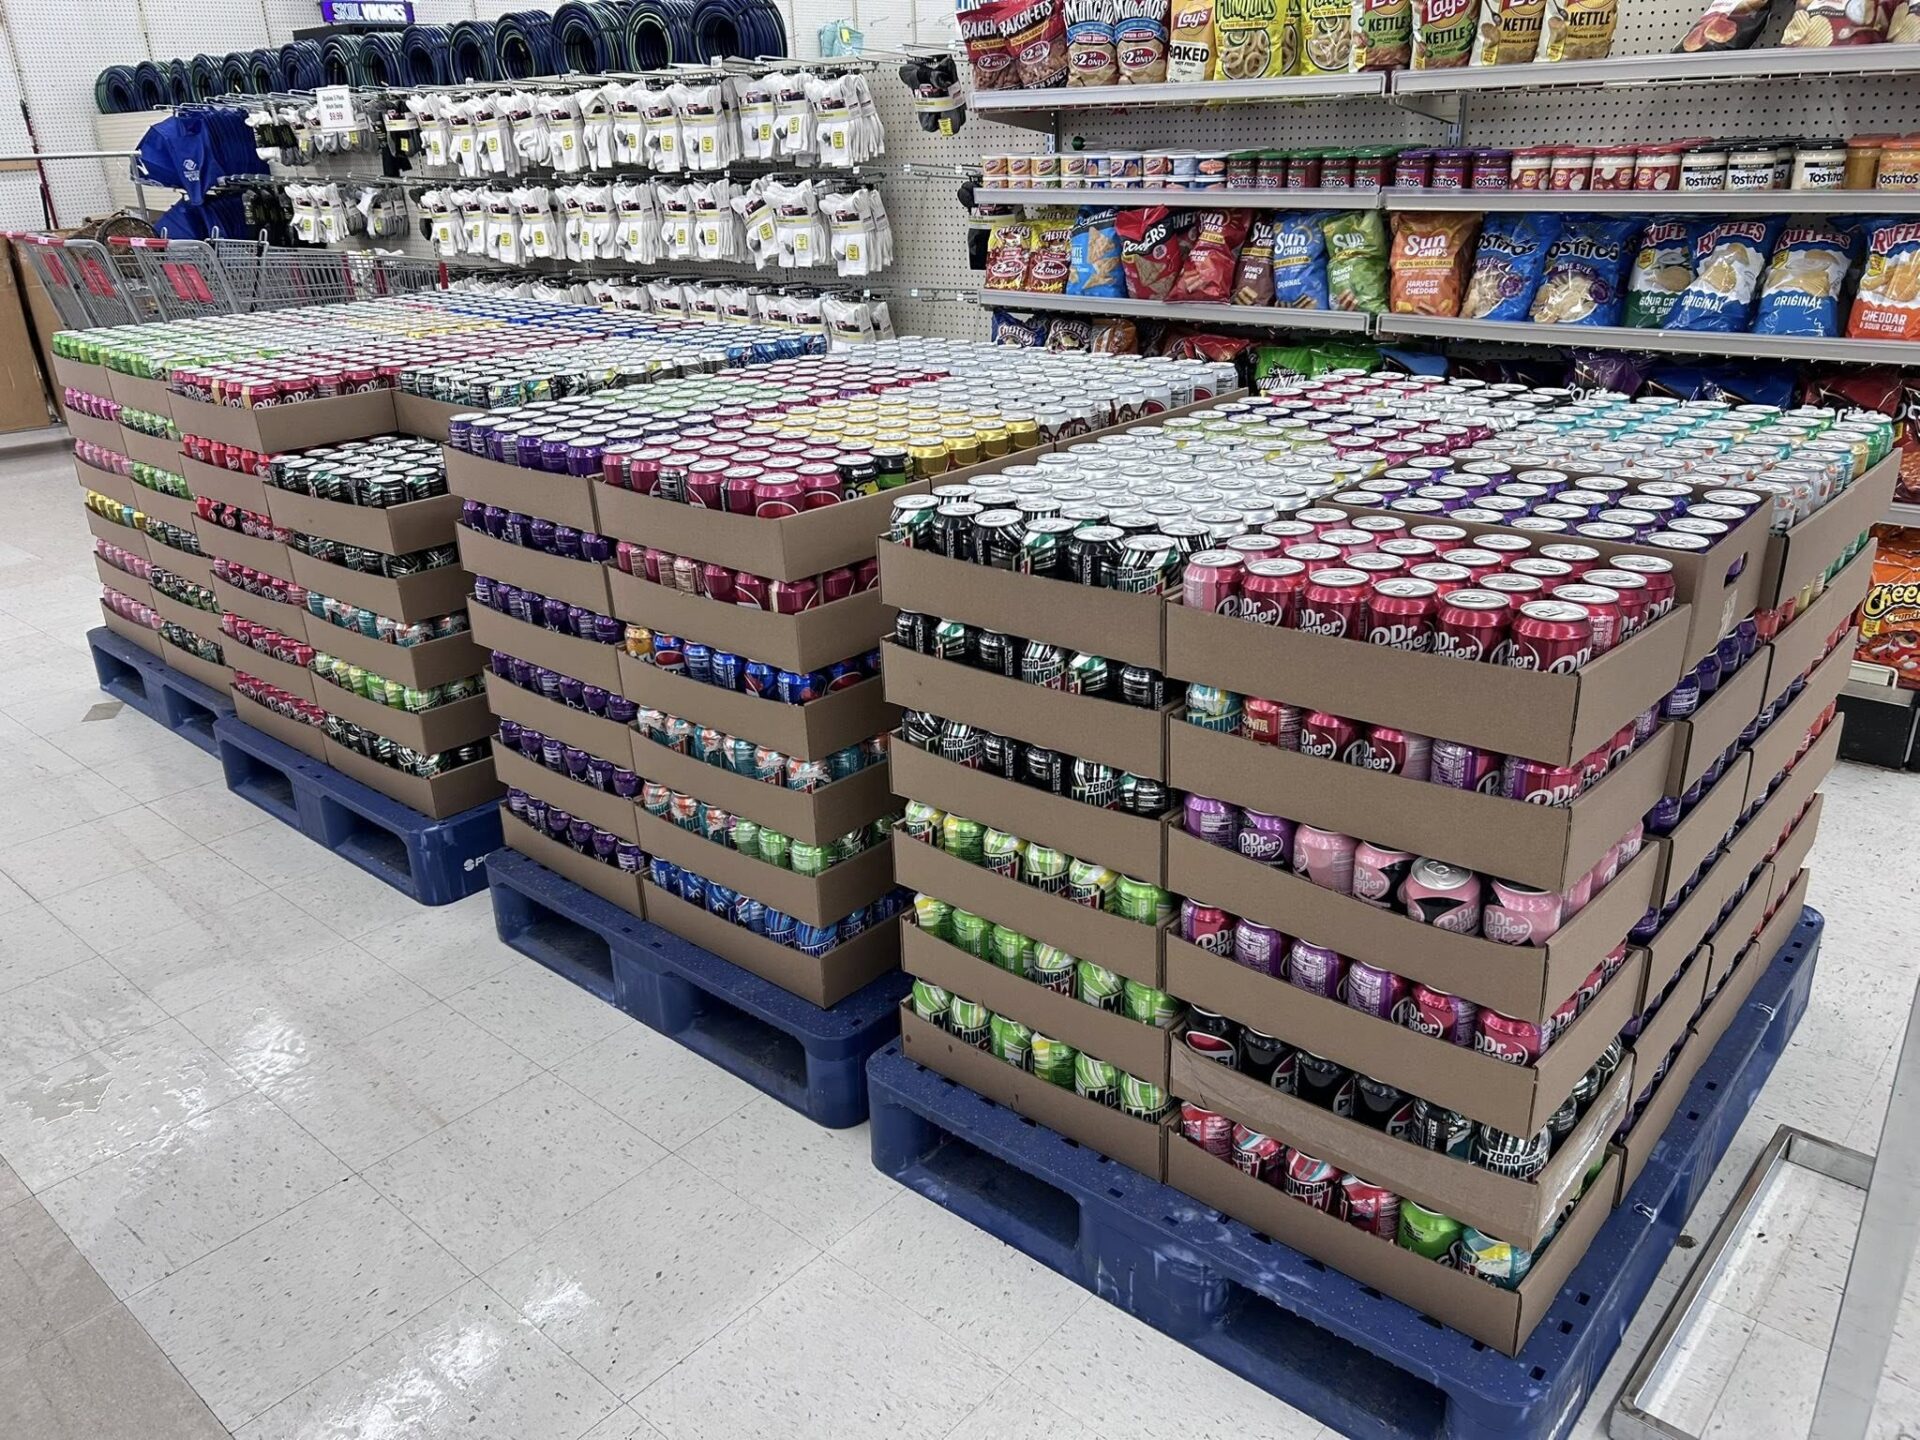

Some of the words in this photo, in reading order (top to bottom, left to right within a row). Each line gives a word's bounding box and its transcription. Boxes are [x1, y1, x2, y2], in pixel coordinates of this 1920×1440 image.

[360, 3, 407, 22] VIKINGS
[999, 2, 1054, 37] BAKEN-ETS
[1064, 0, 1114, 26] Muncho
[1177, 10, 1208, 27] Lay's
[1428, 0, 1466, 22] Lays
[1569, 11, 1611, 26] KETTLE
[961, 19, 996, 40] BAKEN
[1368, 16, 1407, 32] KETTLE
[1503, 17, 1542, 31] KETTL
[1425, 27, 1465, 44] KETTLE
[1073, 55, 1087, 64] $2
[1122, 52, 1134, 63] $2
[1685, 174, 1722, 187] TOSTITOS
[1731, 173, 1768, 186] TOSTITOS
[1809, 171, 1843, 184] TOSTITO
[1251, 222, 1273, 243] Su
[1641, 222, 1687, 250] RUFF
[1697, 221, 1766, 256] RUFFLES
[1775, 228, 1851, 251] RUFFLES
[1256, 239, 1273, 247] CHIP
[1275, 232, 1305, 255] Sun
[1283, 246, 1308, 256] CHIPS
[1404, 234, 1446, 256] Sun
[1478, 233, 1541, 257] OSTITOS
[1551, 238, 1620, 261] OSTITOS
[1418, 247, 1447, 258] CHIPS
[1416, 259, 1435, 267] WHOLE
[1405, 287, 1440, 295] CHEDDAR
[1406, 279, 1440, 288] HARVEST
[1682, 294, 1725, 314] ORIGINAL
[1773, 295, 1824, 309] ORIGINAL
[1861, 309, 1907, 325] CHEDDAR
[1120, 574, 1159, 593] UNTAIN
[1242, 597, 1261, 616] Dr
[1863, 583, 1920, 619] Chee
[1302, 608, 1325, 629] Dr
[1886, 611, 1920, 624] Crunch
[1390, 624, 1417, 646] Dr
[1438, 631, 1460, 650] Dr
[1302, 728, 1317, 746] Dr
[1087, 778, 1114, 794] ZERO
[1072, 786, 1119, 809] MOUN
[1250, 831, 1268, 846] Dr
[985, 854, 1012, 870] NTAIN
[1355, 866, 1370, 880] Dr
[1027, 872, 1069, 893] MOUN
[1497, 911, 1514, 926] Dr
[1033, 967, 1072, 986] OUNTAIN
[1409, 1003, 1424, 1021] Dr
[1484, 1035, 1506, 1053] Dr
[1490, 1151, 1520, 1165] ZERO
[1286, 1178, 1327, 1197] UNTAIN
